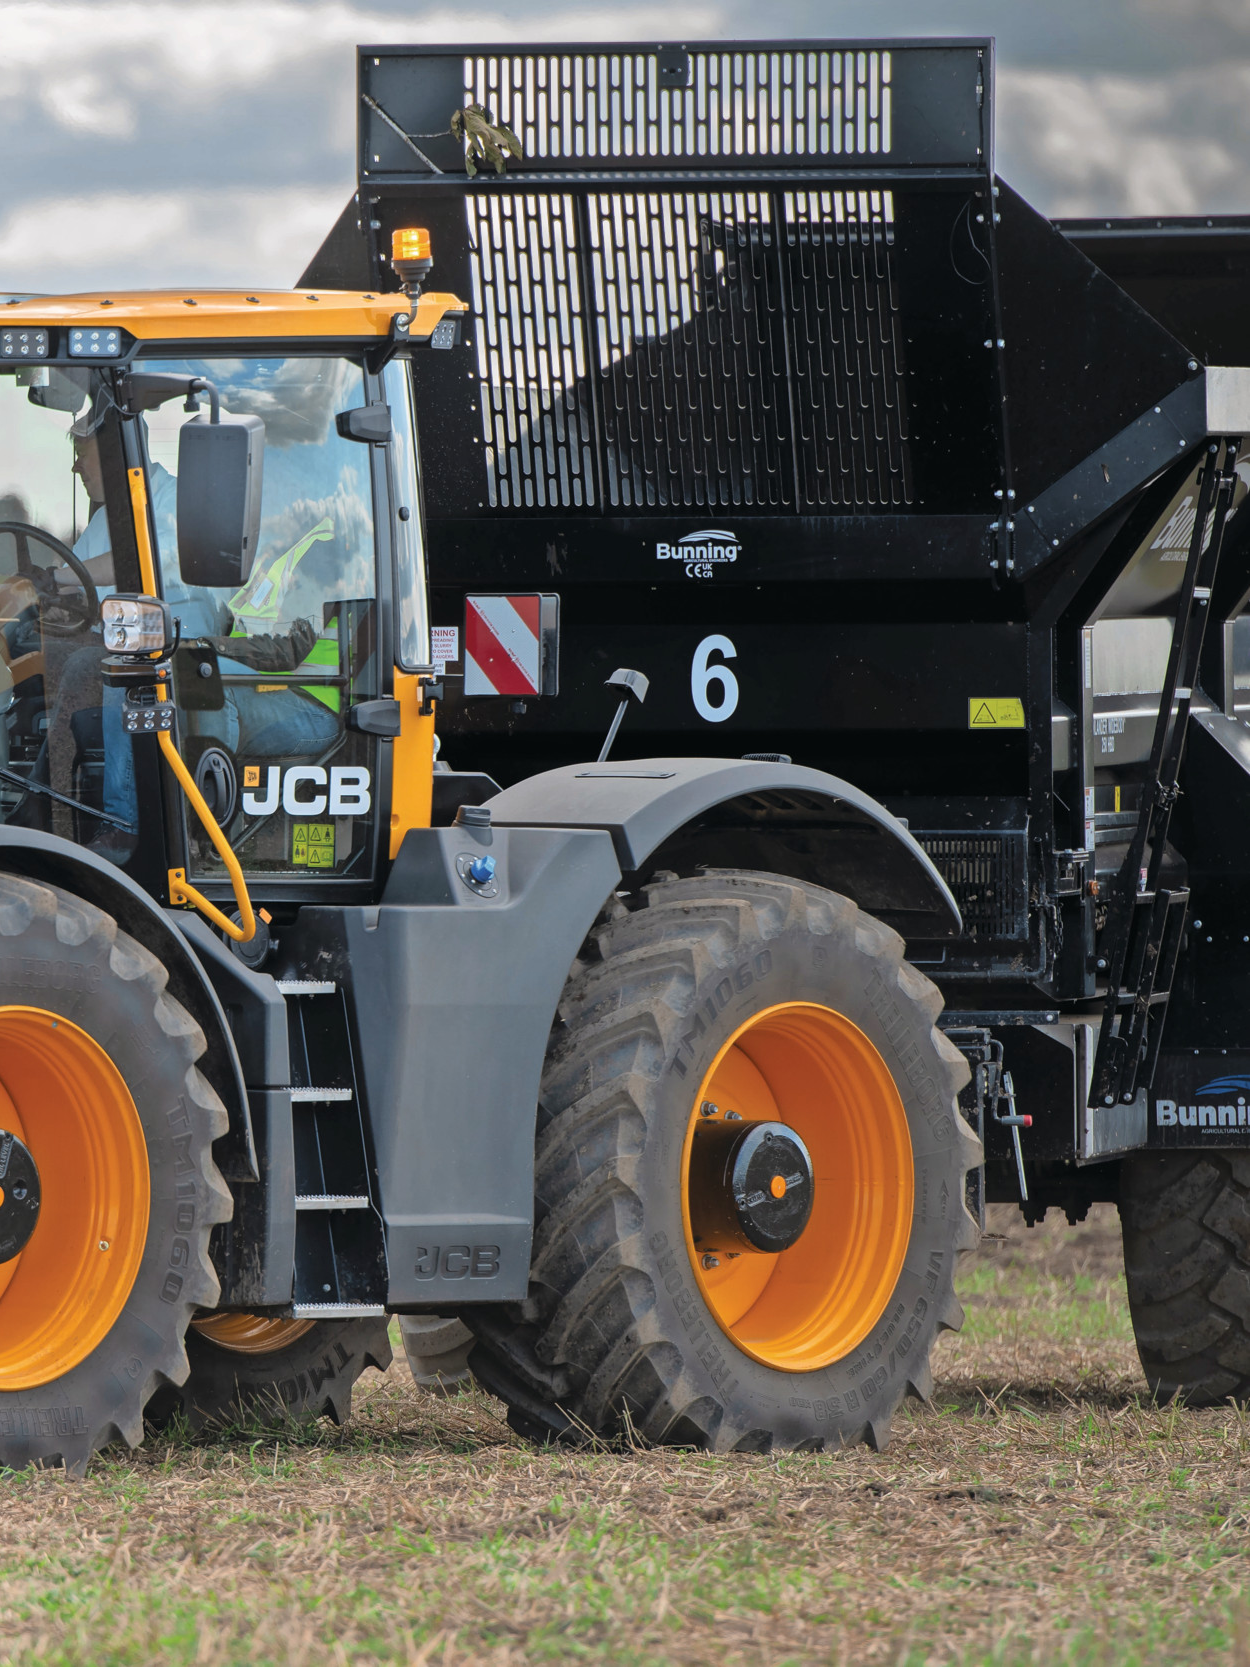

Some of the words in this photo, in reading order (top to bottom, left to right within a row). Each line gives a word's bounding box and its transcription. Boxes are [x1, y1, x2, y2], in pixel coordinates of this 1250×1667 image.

[656, 542, 739, 562] Bunning
[691, 634, 740, 723] 6
[242, 766, 372, 816] JCB
[668, 949, 773, 1080] TM1060
[1155, 1096, 1250, 1127] Bunni
[158, 1094, 198, 1305] TM1060
[414, 1245, 502, 1282] JCB
